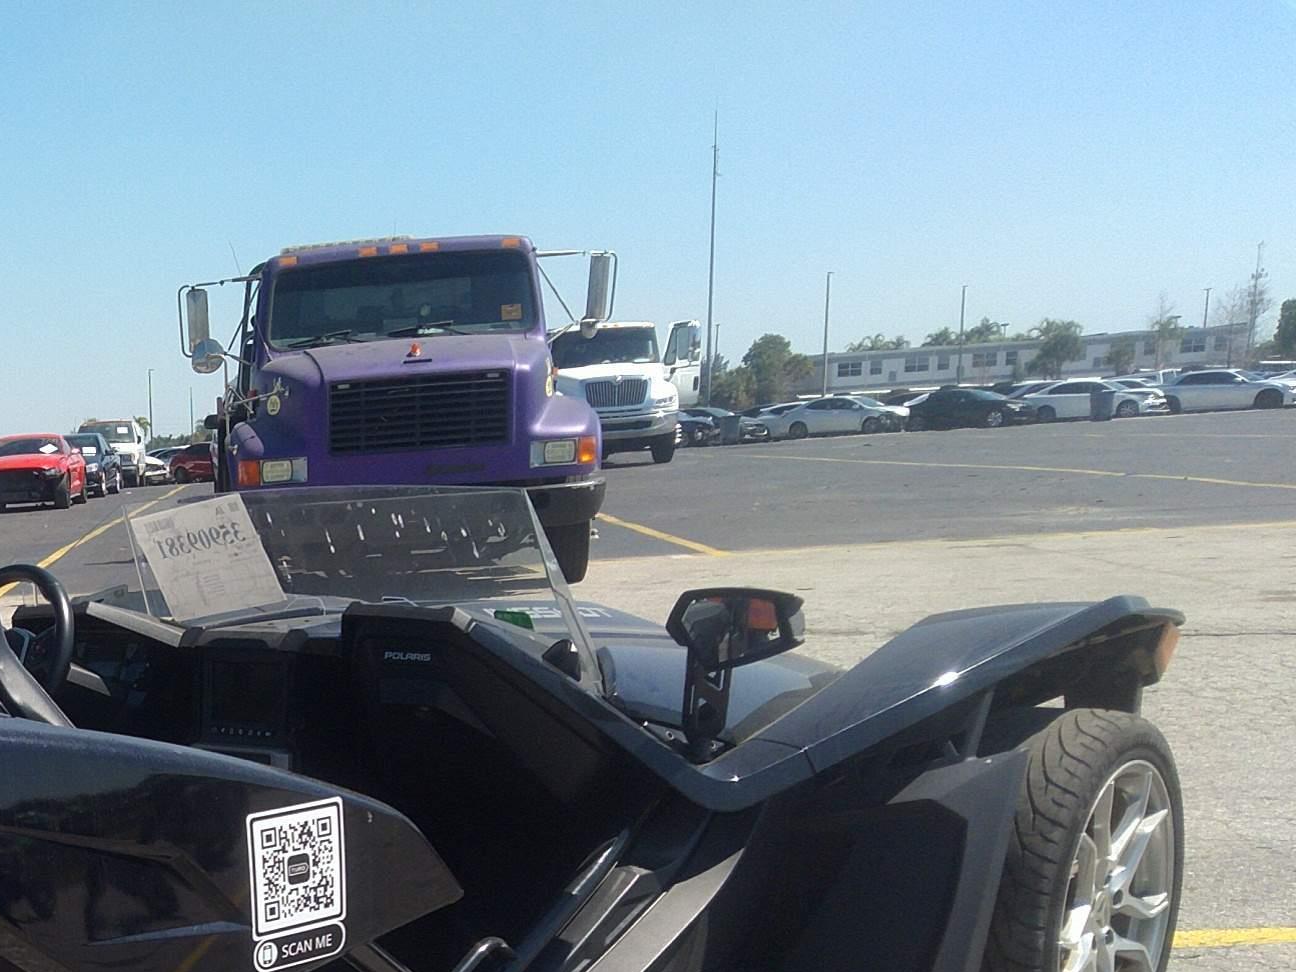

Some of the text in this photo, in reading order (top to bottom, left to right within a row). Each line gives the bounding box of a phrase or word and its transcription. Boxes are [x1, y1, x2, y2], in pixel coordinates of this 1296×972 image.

[384, 651, 432, 661] POLARIS
[281, 933, 333, 959] SCAN ME
